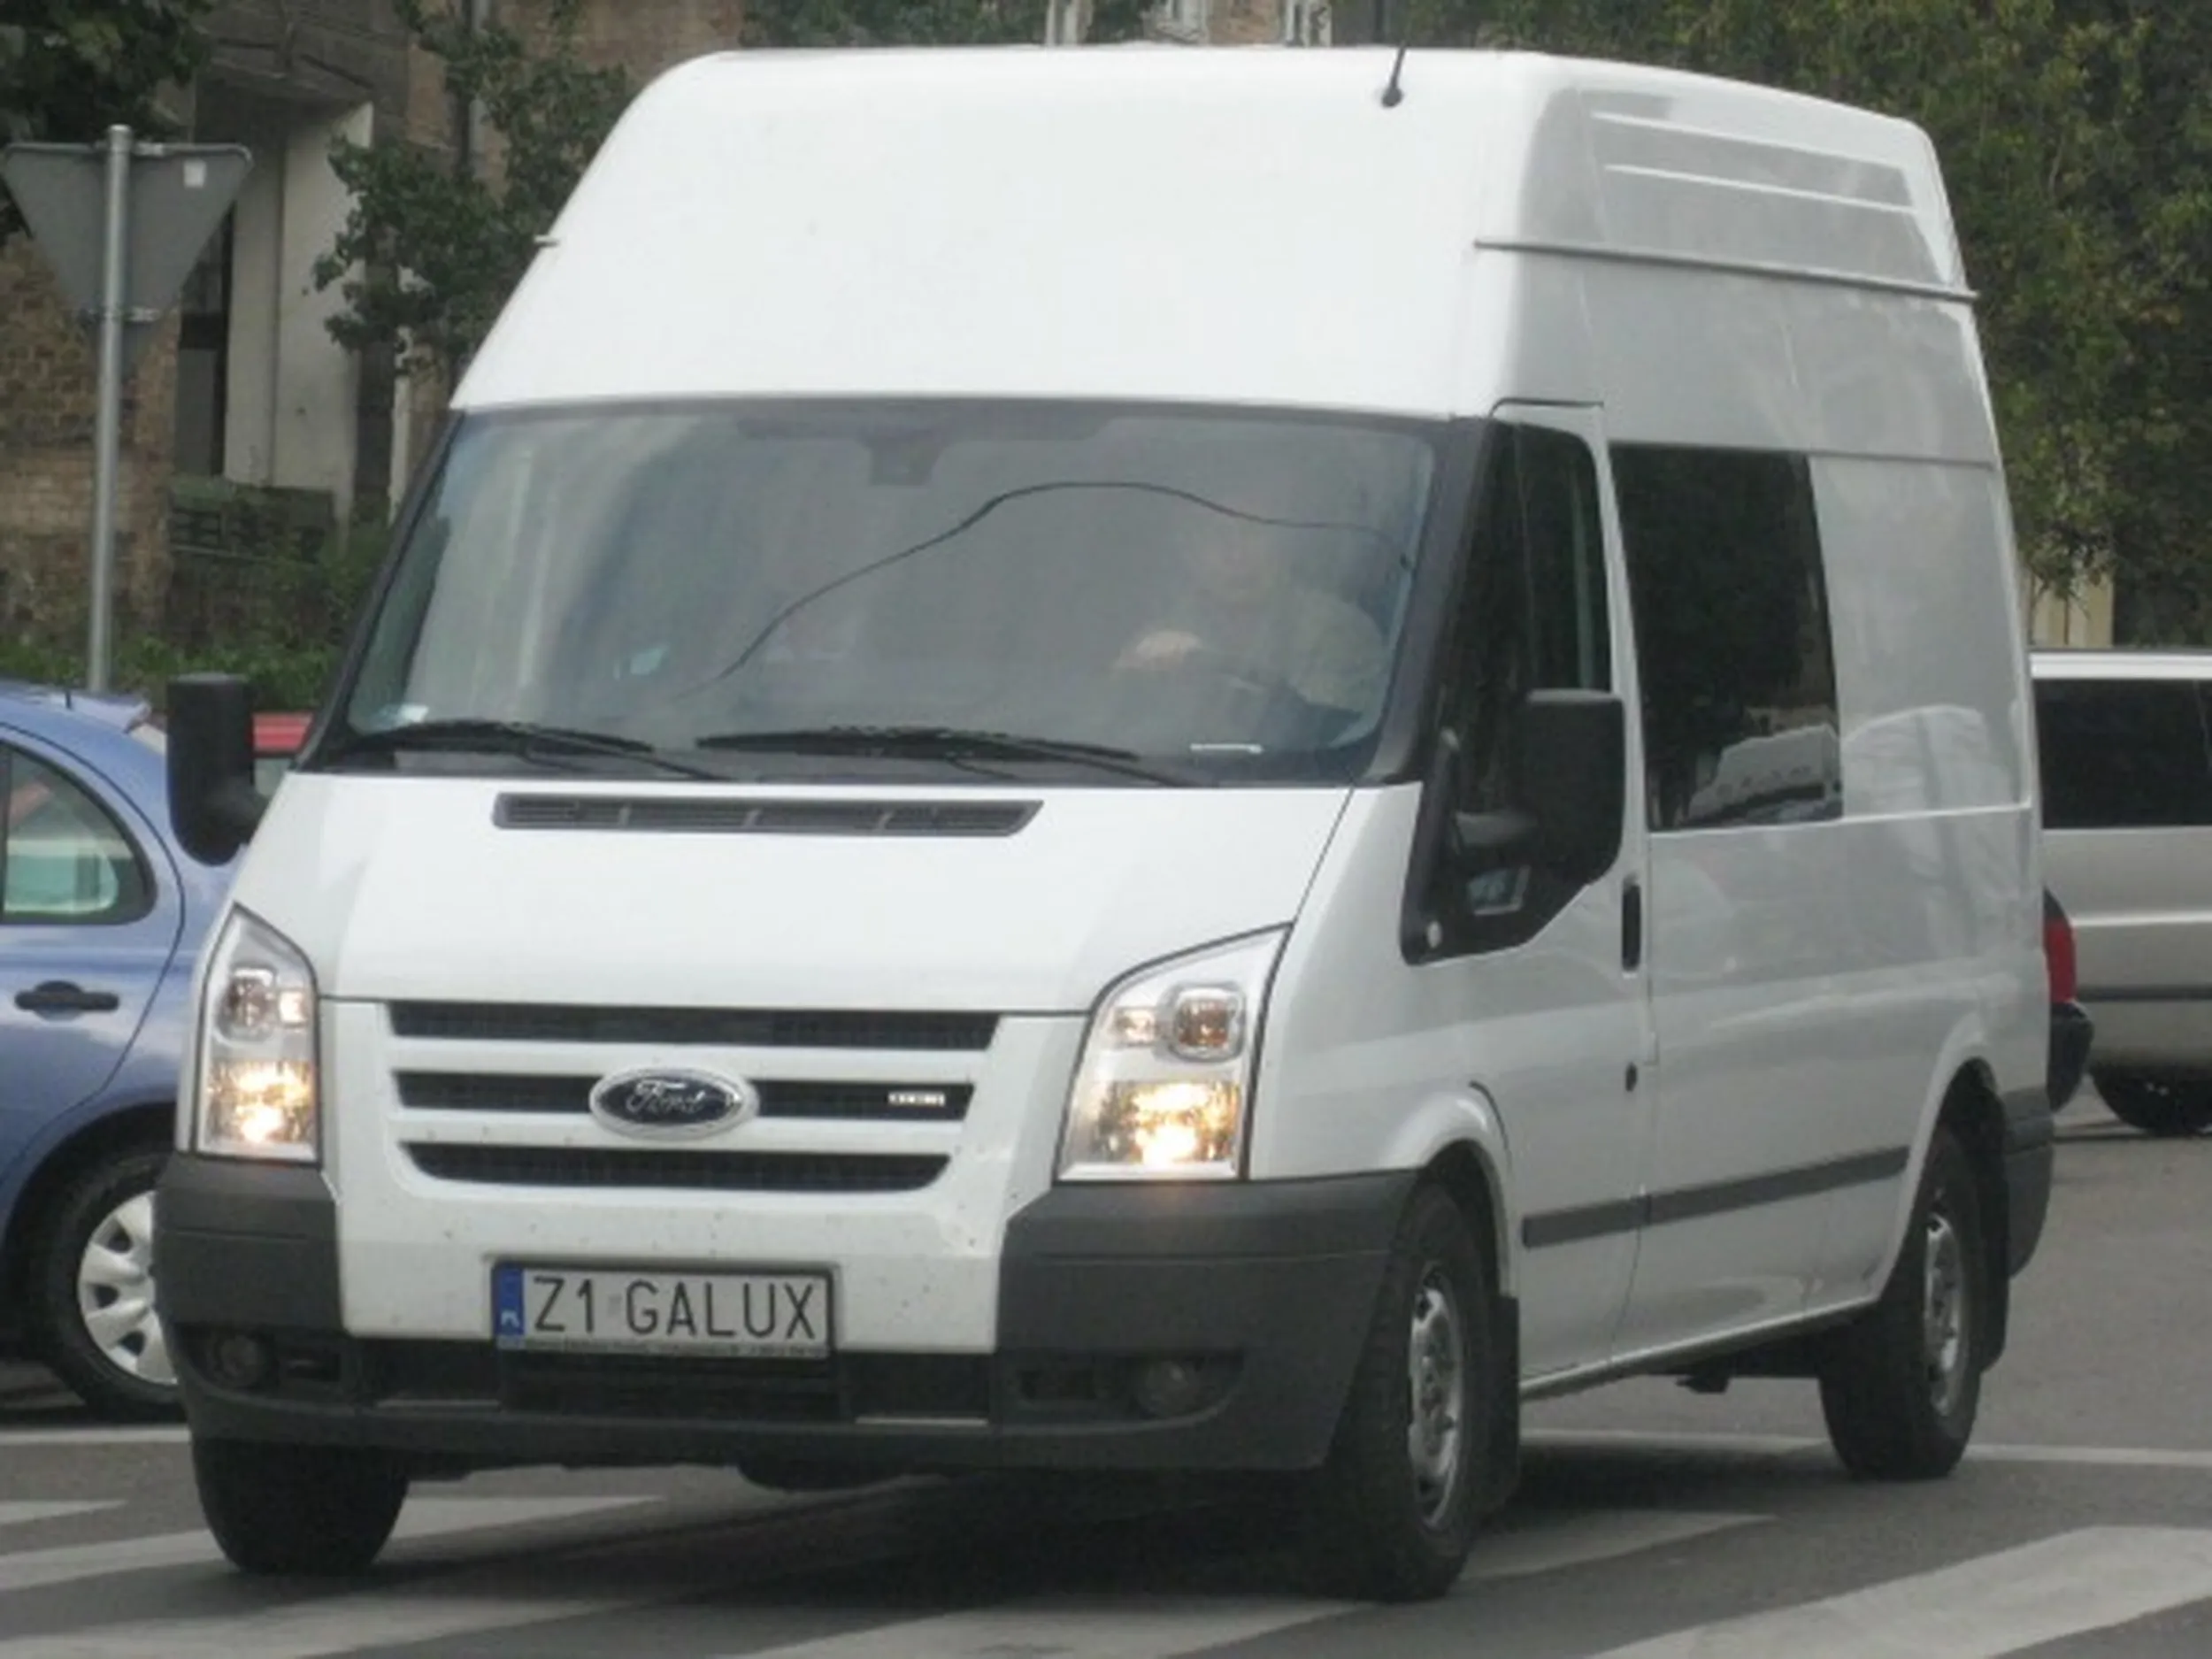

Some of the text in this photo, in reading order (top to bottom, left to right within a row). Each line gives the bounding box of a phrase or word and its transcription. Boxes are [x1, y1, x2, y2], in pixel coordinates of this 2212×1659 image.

[625, 1079, 706, 1114] Ford
[534, 1275, 816, 1340] Z1 GALUX
